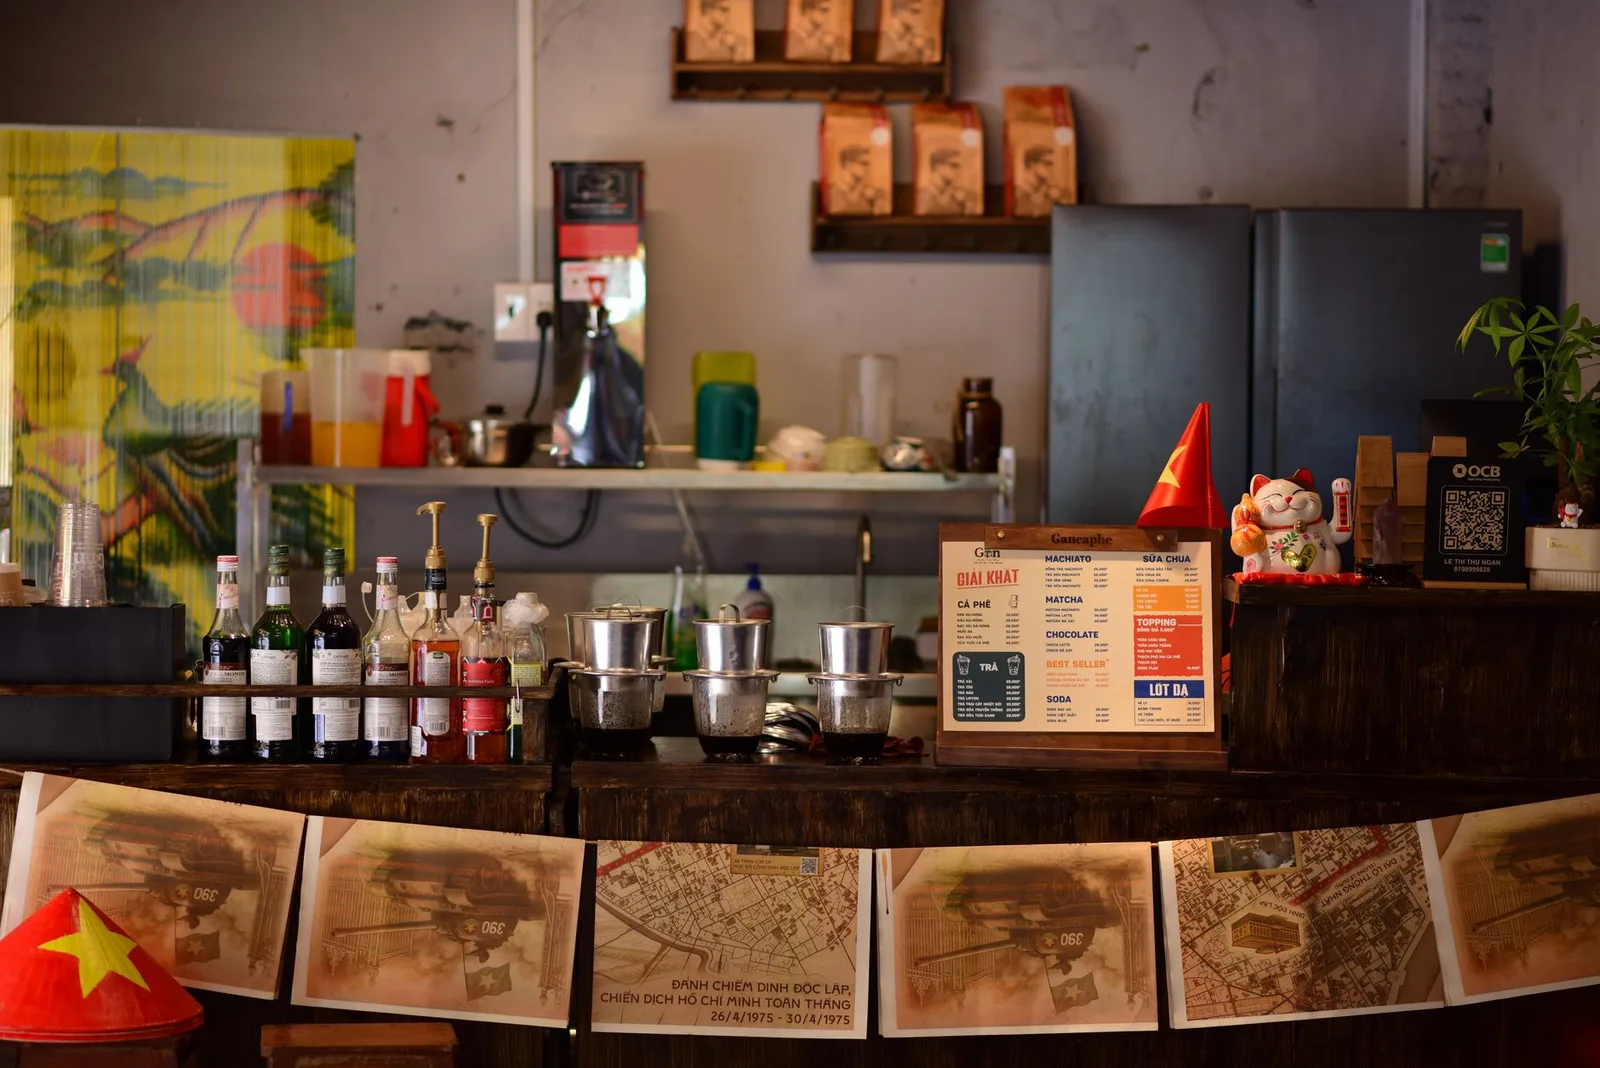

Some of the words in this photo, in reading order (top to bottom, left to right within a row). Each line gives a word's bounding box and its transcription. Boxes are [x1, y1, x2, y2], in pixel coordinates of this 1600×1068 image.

[1468, 465, 1500, 478] OCB
[1045, 555, 1092, 563] MACHIATO
[1143, 554, 1163, 563] SỮA
[1166, 555, 1191, 563] CHUA
[973, 599, 991, 608] PHÊ
[1137, 618, 1177, 626] TOPPING
[1046, 660, 1069, 668] BEST
[194, 887, 218, 902] 390
[481, 921, 505, 935] 390
[1060, 932, 1083, 945] 390
[672, 977, 709, 991] ĐÁNH
[712, 978, 753, 992] CHIẾM
[758, 983, 788, 993] DINH
[794, 982, 820, 994] ĐỘC
[600, 990, 639, 1003] CHIẾN
[644, 994, 673, 1006] DỊCH
[701, 994, 723, 1006] CHÍ
[728, 998, 761, 1008] MINH
[805, 995, 850, 1010] THẮNG
[711, 1011, 774, 1024] 26/4/1975
[786, 1013, 850, 1025] 30/4/1975
